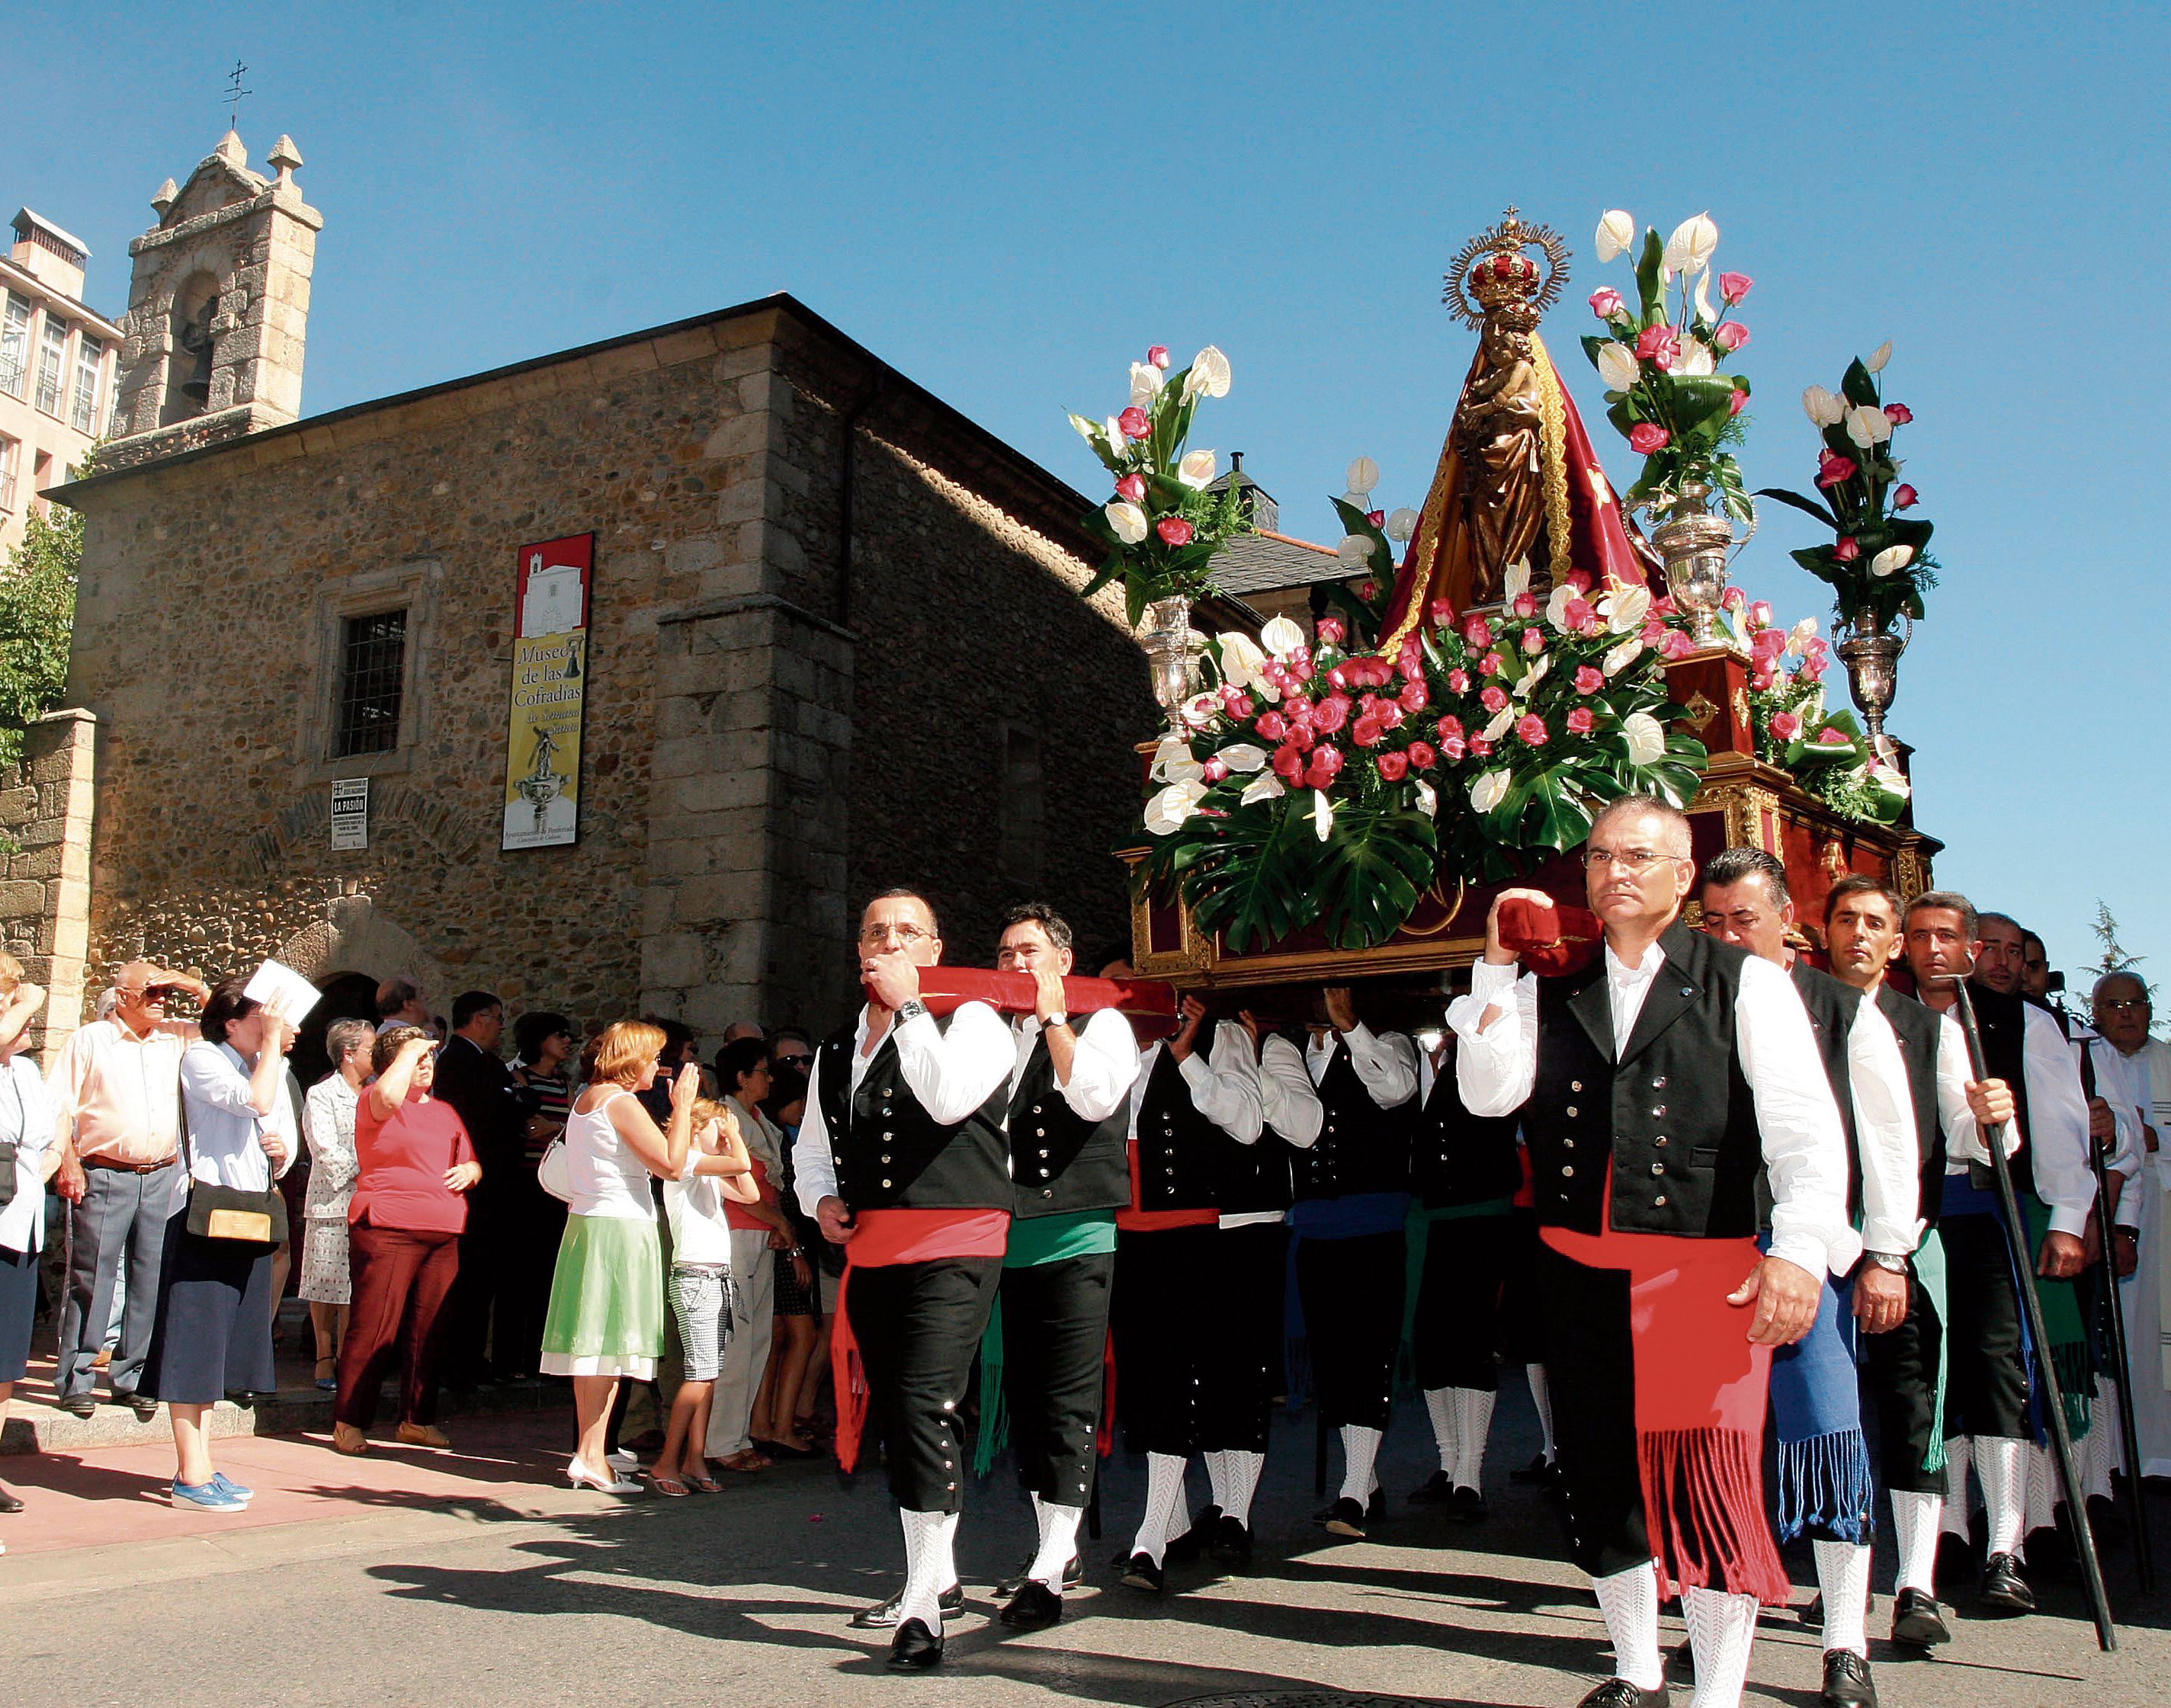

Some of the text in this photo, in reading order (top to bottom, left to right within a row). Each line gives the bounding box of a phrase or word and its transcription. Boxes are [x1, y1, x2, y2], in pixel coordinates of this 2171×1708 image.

[518, 646, 569, 665] Museo
[521, 665, 563, 684] de las
[515, 684, 581, 707] Cofradías
[334, 797, 364, 812] LA PASIÓN
